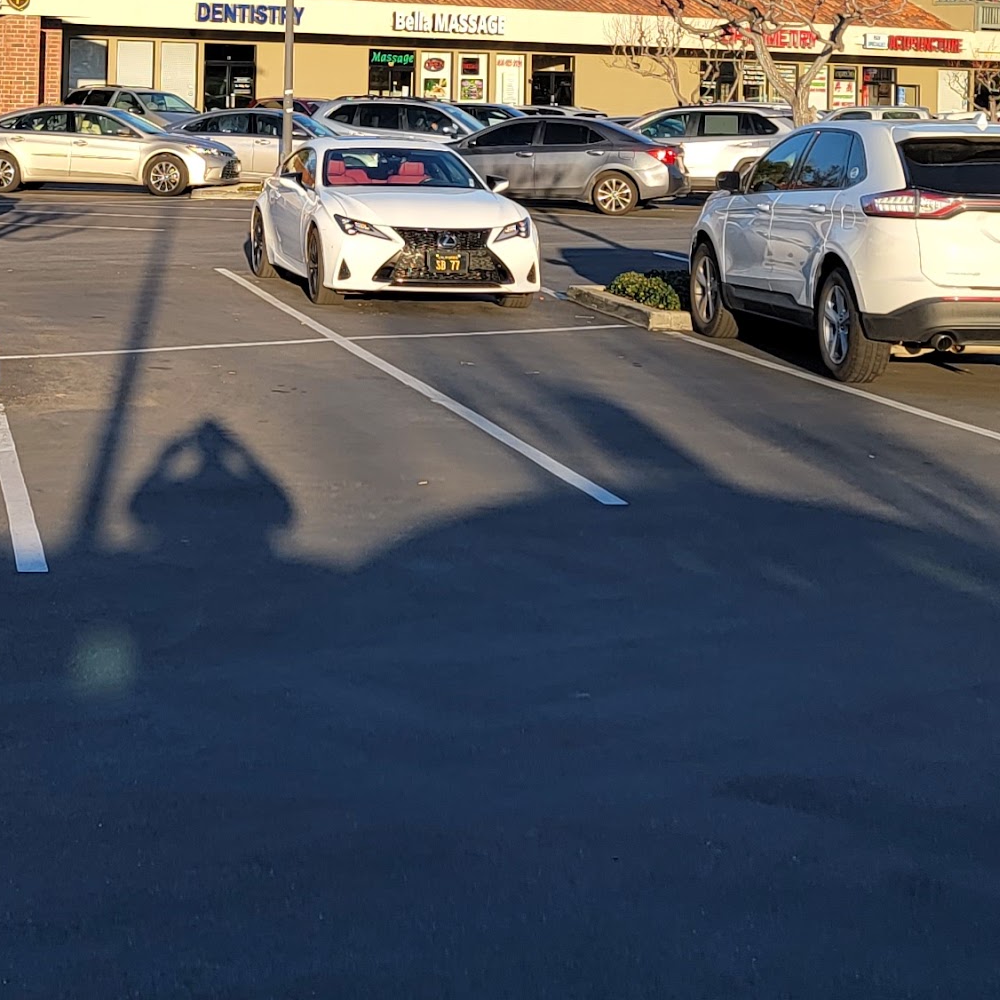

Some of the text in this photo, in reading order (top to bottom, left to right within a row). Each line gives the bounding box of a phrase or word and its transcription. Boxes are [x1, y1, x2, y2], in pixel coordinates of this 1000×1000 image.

[195, 2, 305, 26] DENTISTRY
[393, 11, 504, 36] Bella MASSAGE
[888, 35, 963, 53] ACUPUNCTURE
[371, 51, 414, 65] Massage
